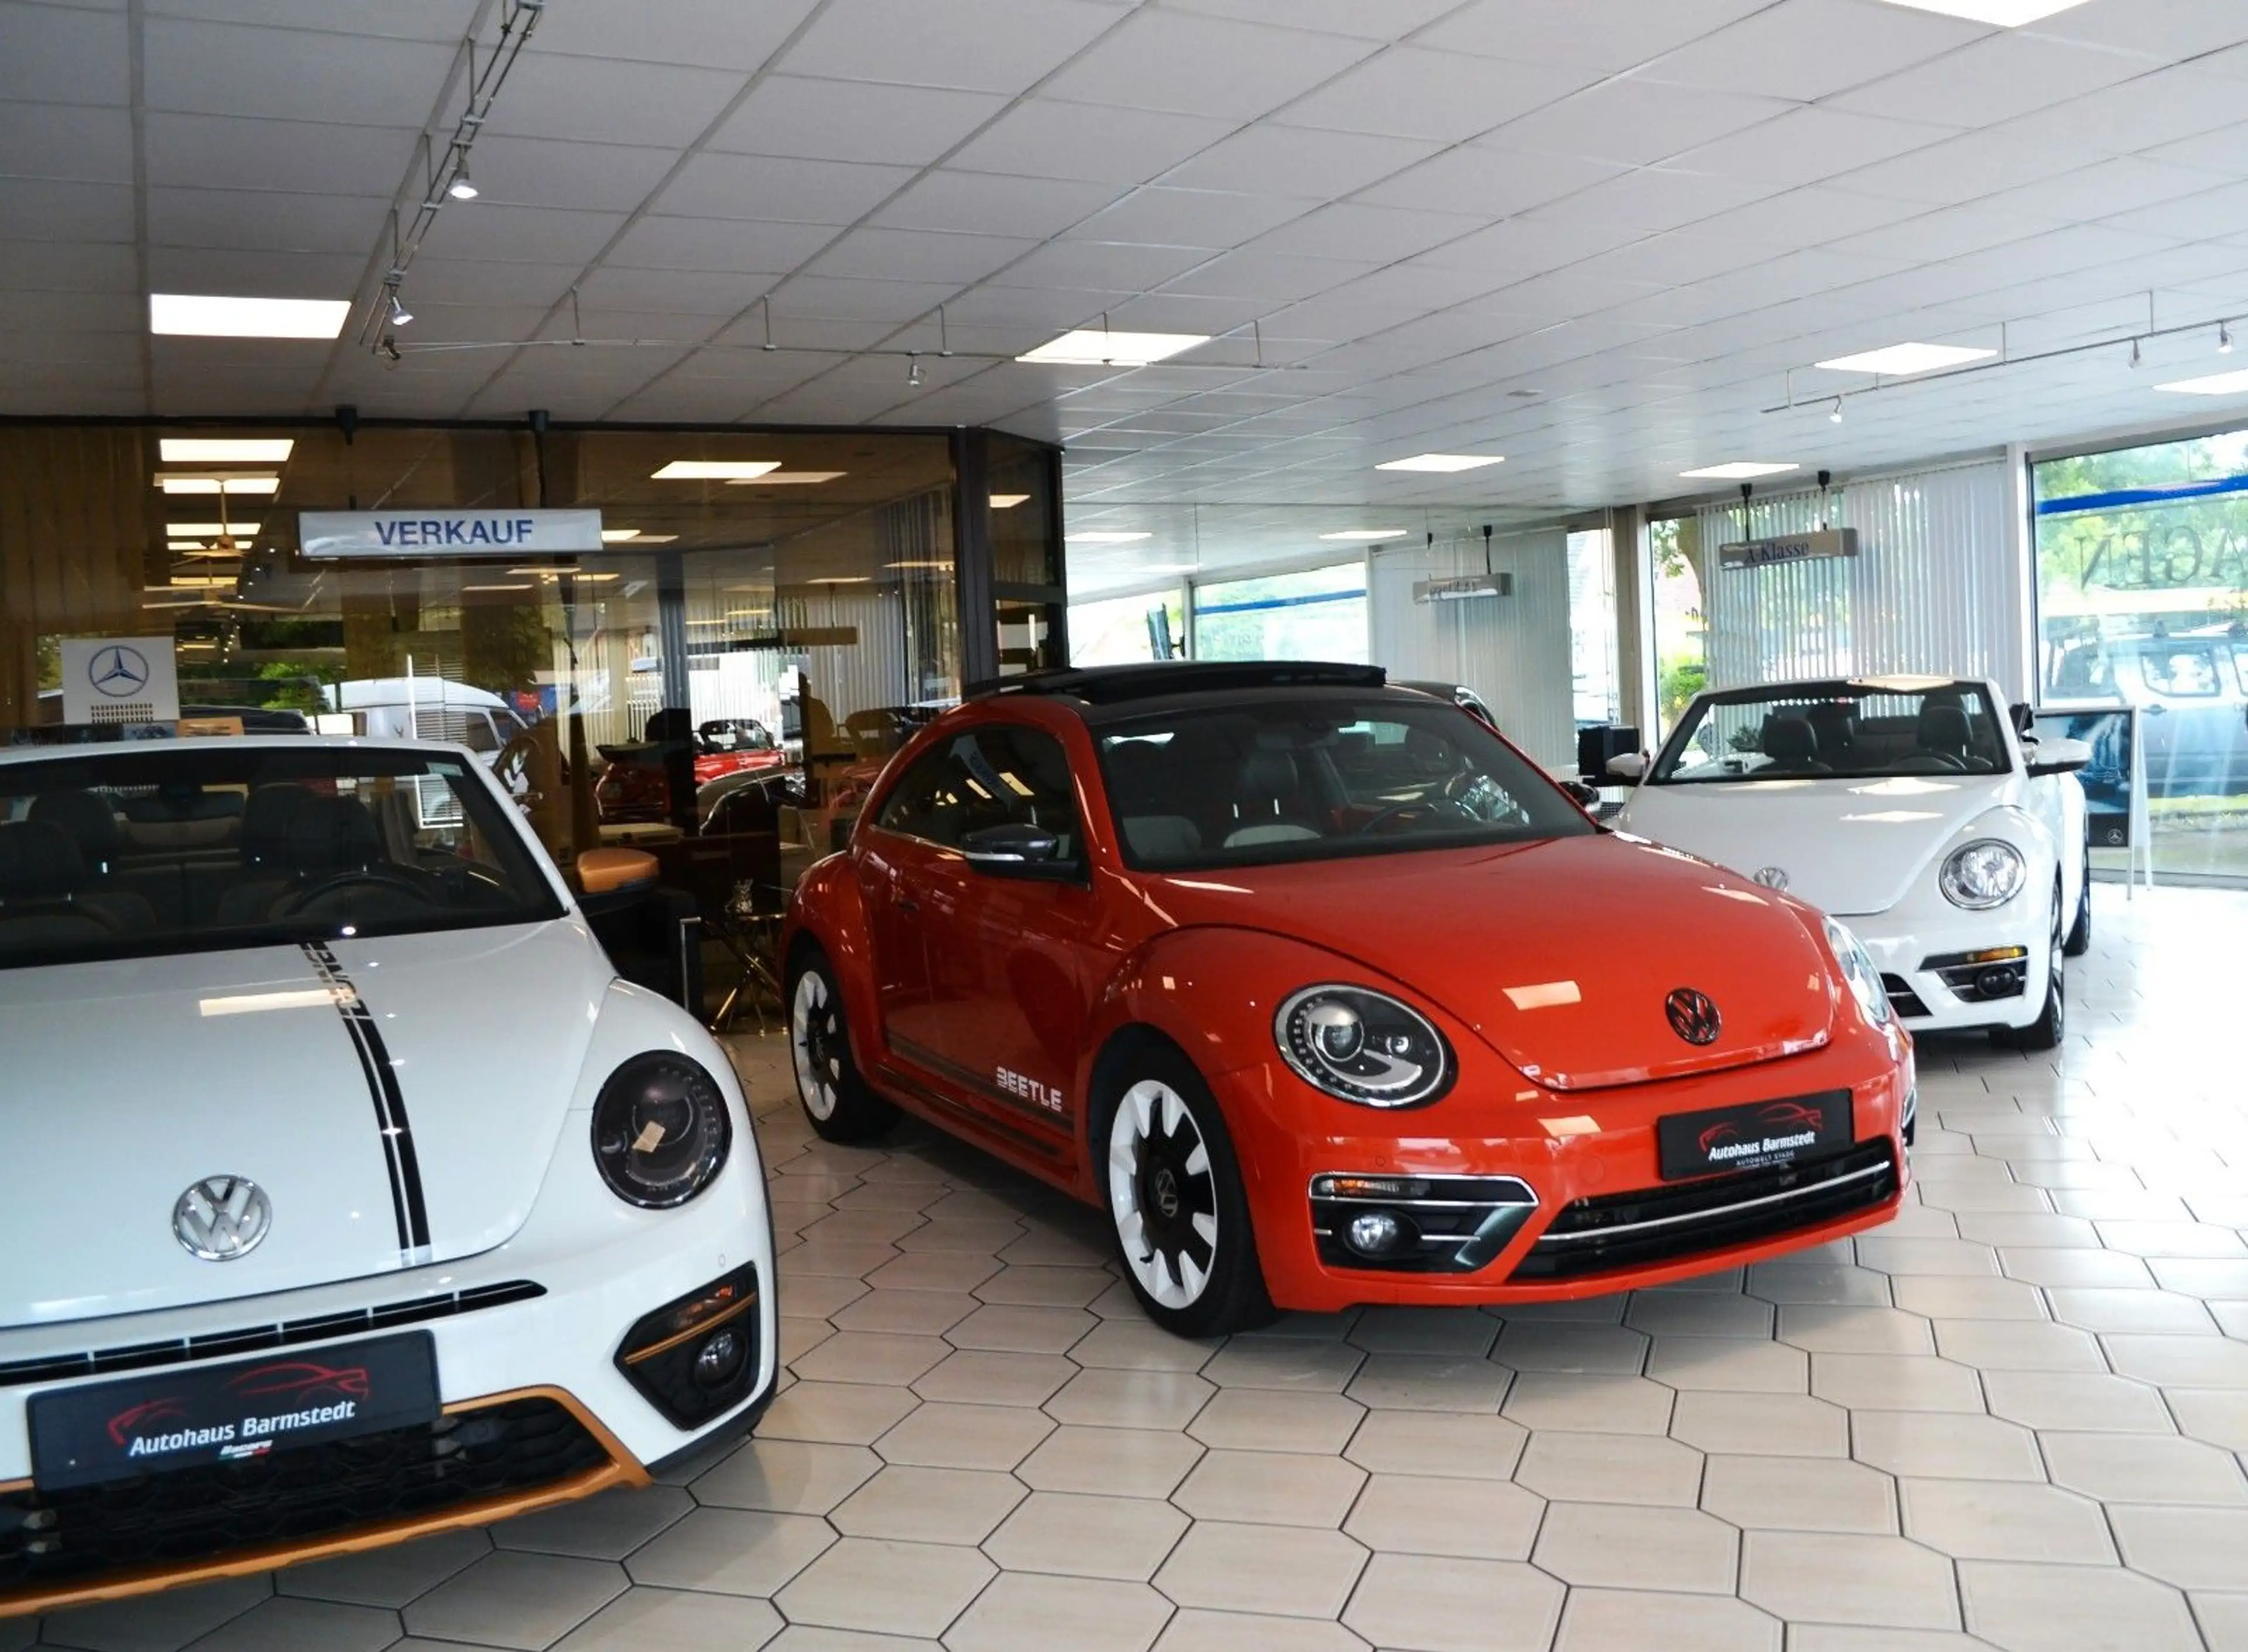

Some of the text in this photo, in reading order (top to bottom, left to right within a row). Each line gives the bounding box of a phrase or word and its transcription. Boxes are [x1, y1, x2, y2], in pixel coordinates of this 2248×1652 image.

[374, 519, 533, 546] VERKAUF
[996, 1065, 1063, 1113] BEETLE
[1708, 1130, 1815, 1161] Autohaus Barmstedt
[129, 1424, 235, 1456] Autohaus
[242, 1400, 356, 1437] Barmstedt
